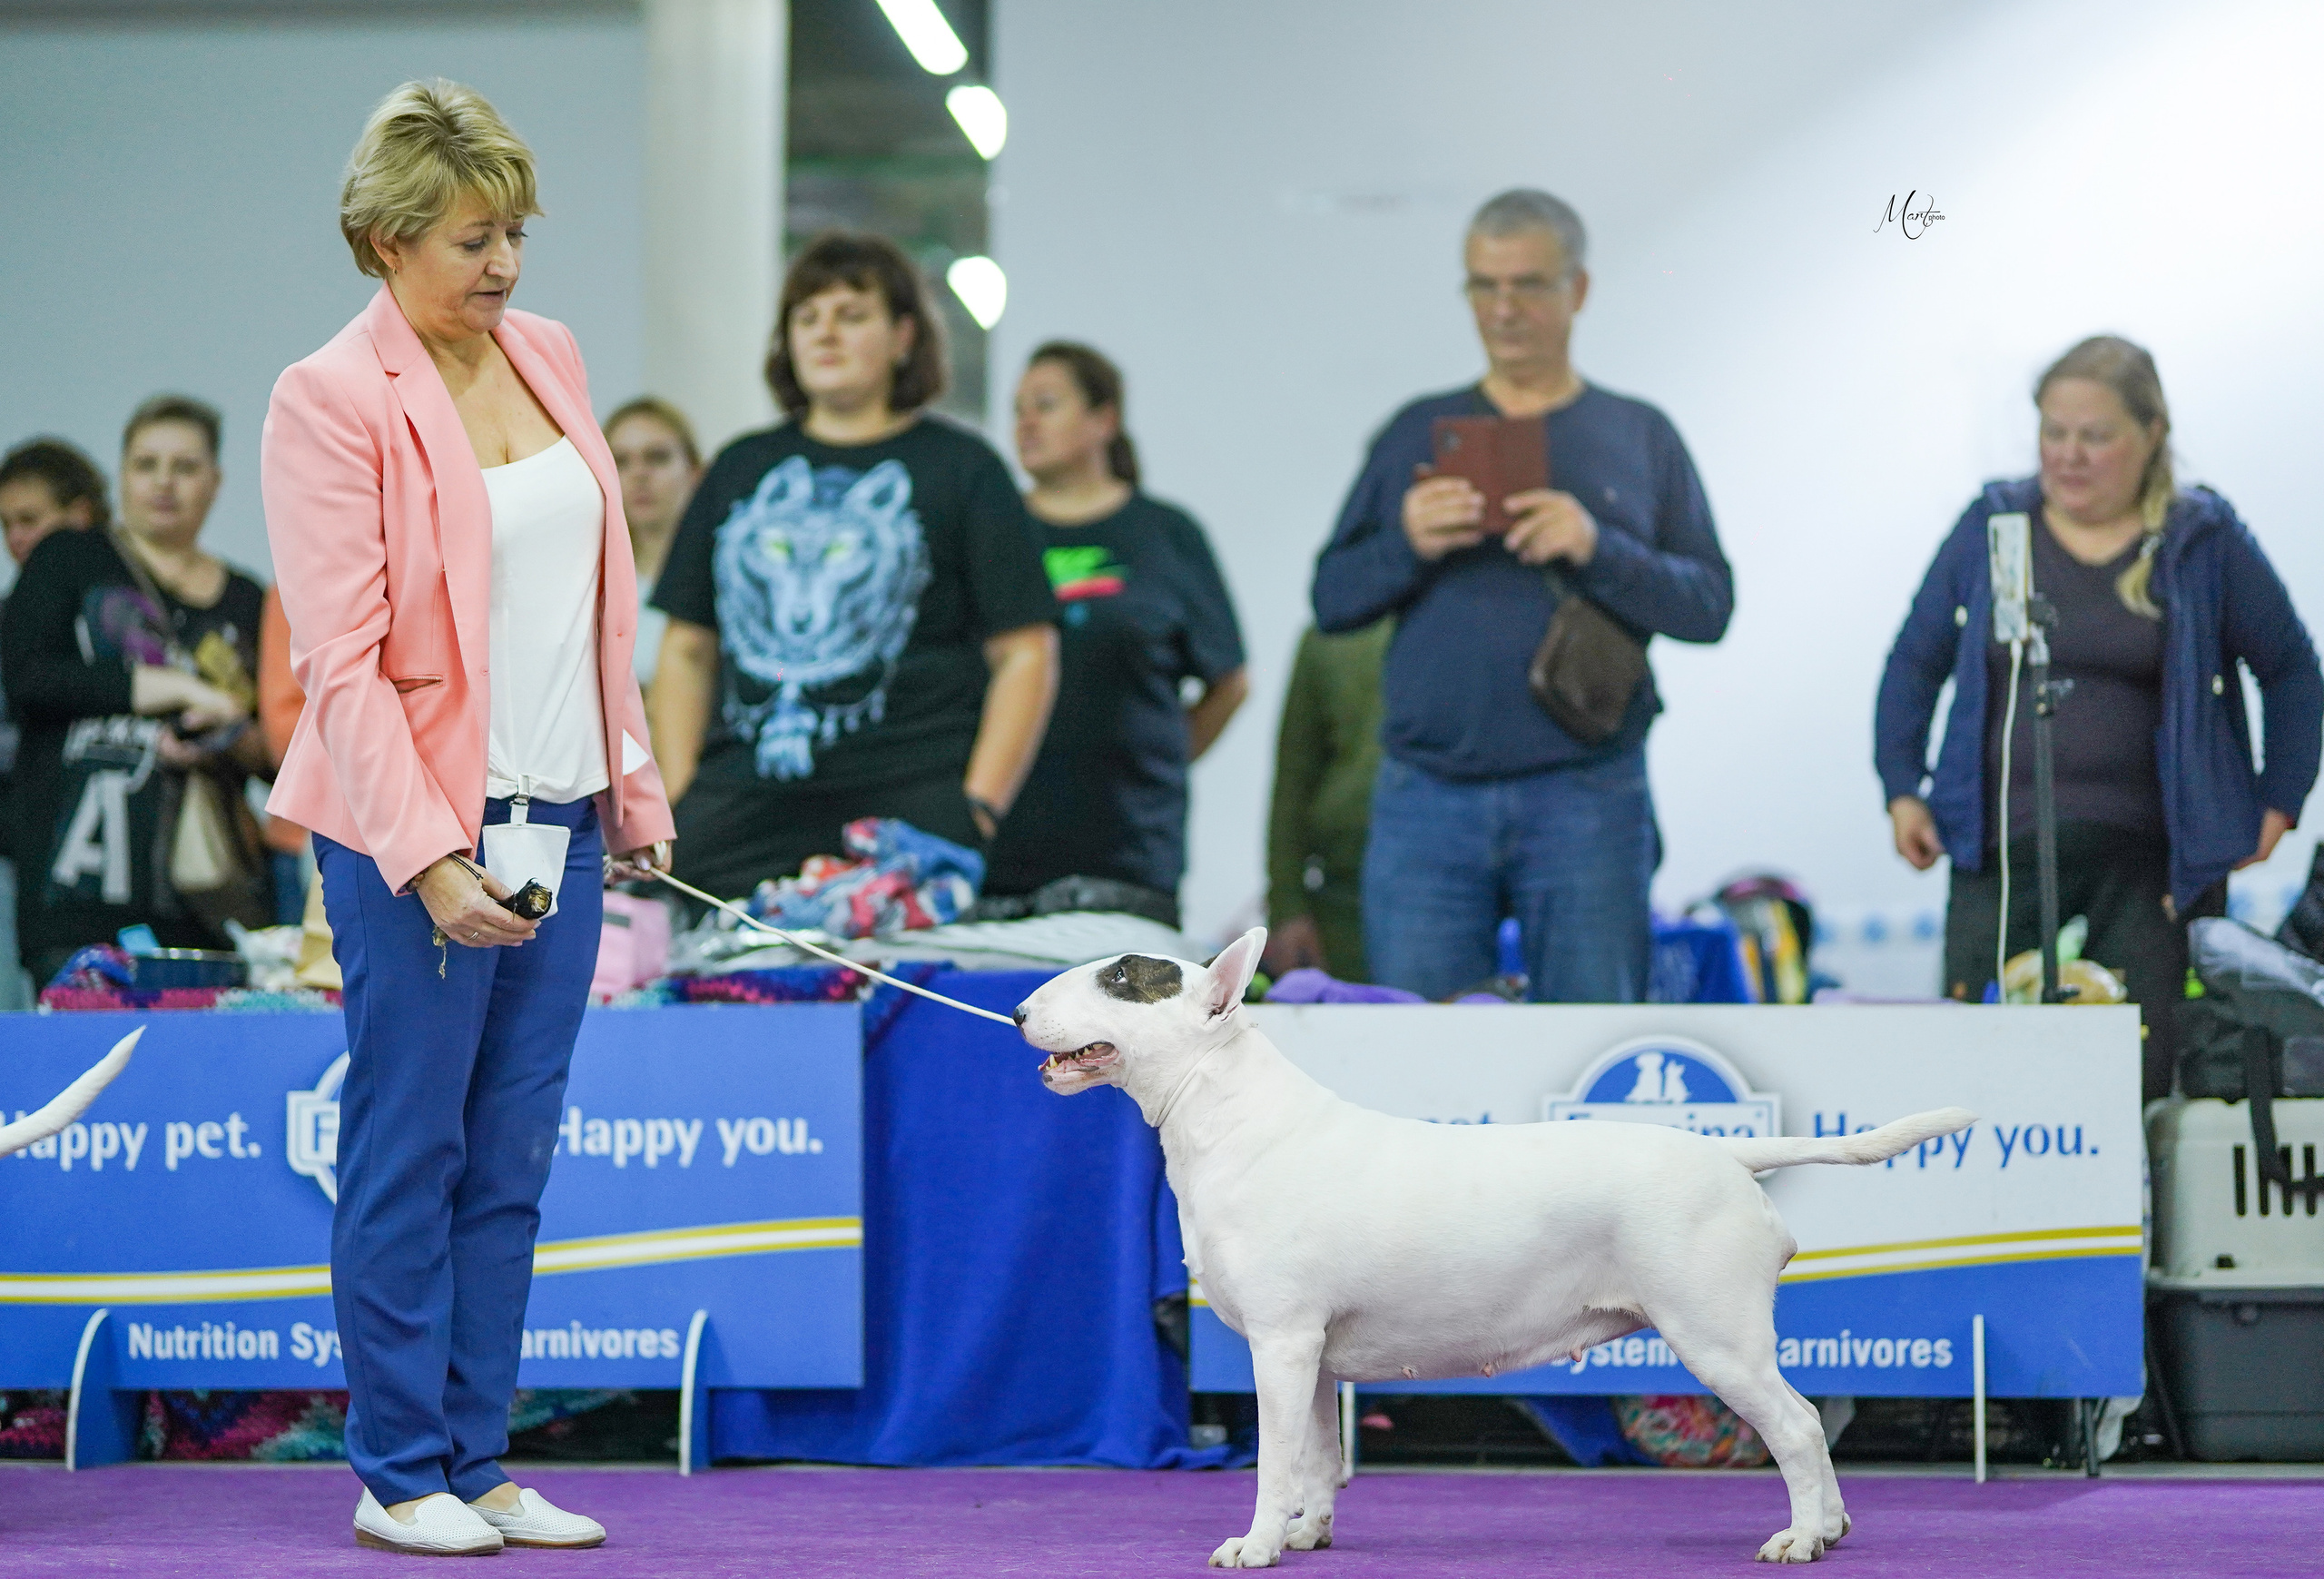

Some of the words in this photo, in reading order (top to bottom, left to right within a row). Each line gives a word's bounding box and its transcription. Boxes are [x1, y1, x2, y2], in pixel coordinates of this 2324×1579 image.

[165, 1112, 261, 1172] pet.
[715, 1117, 823, 1169] you.
[1995, 1124, 2099, 1169] you.
[128, 1321, 280, 1361] Nutrition
[1777, 1328, 1954, 1368] arnivores
